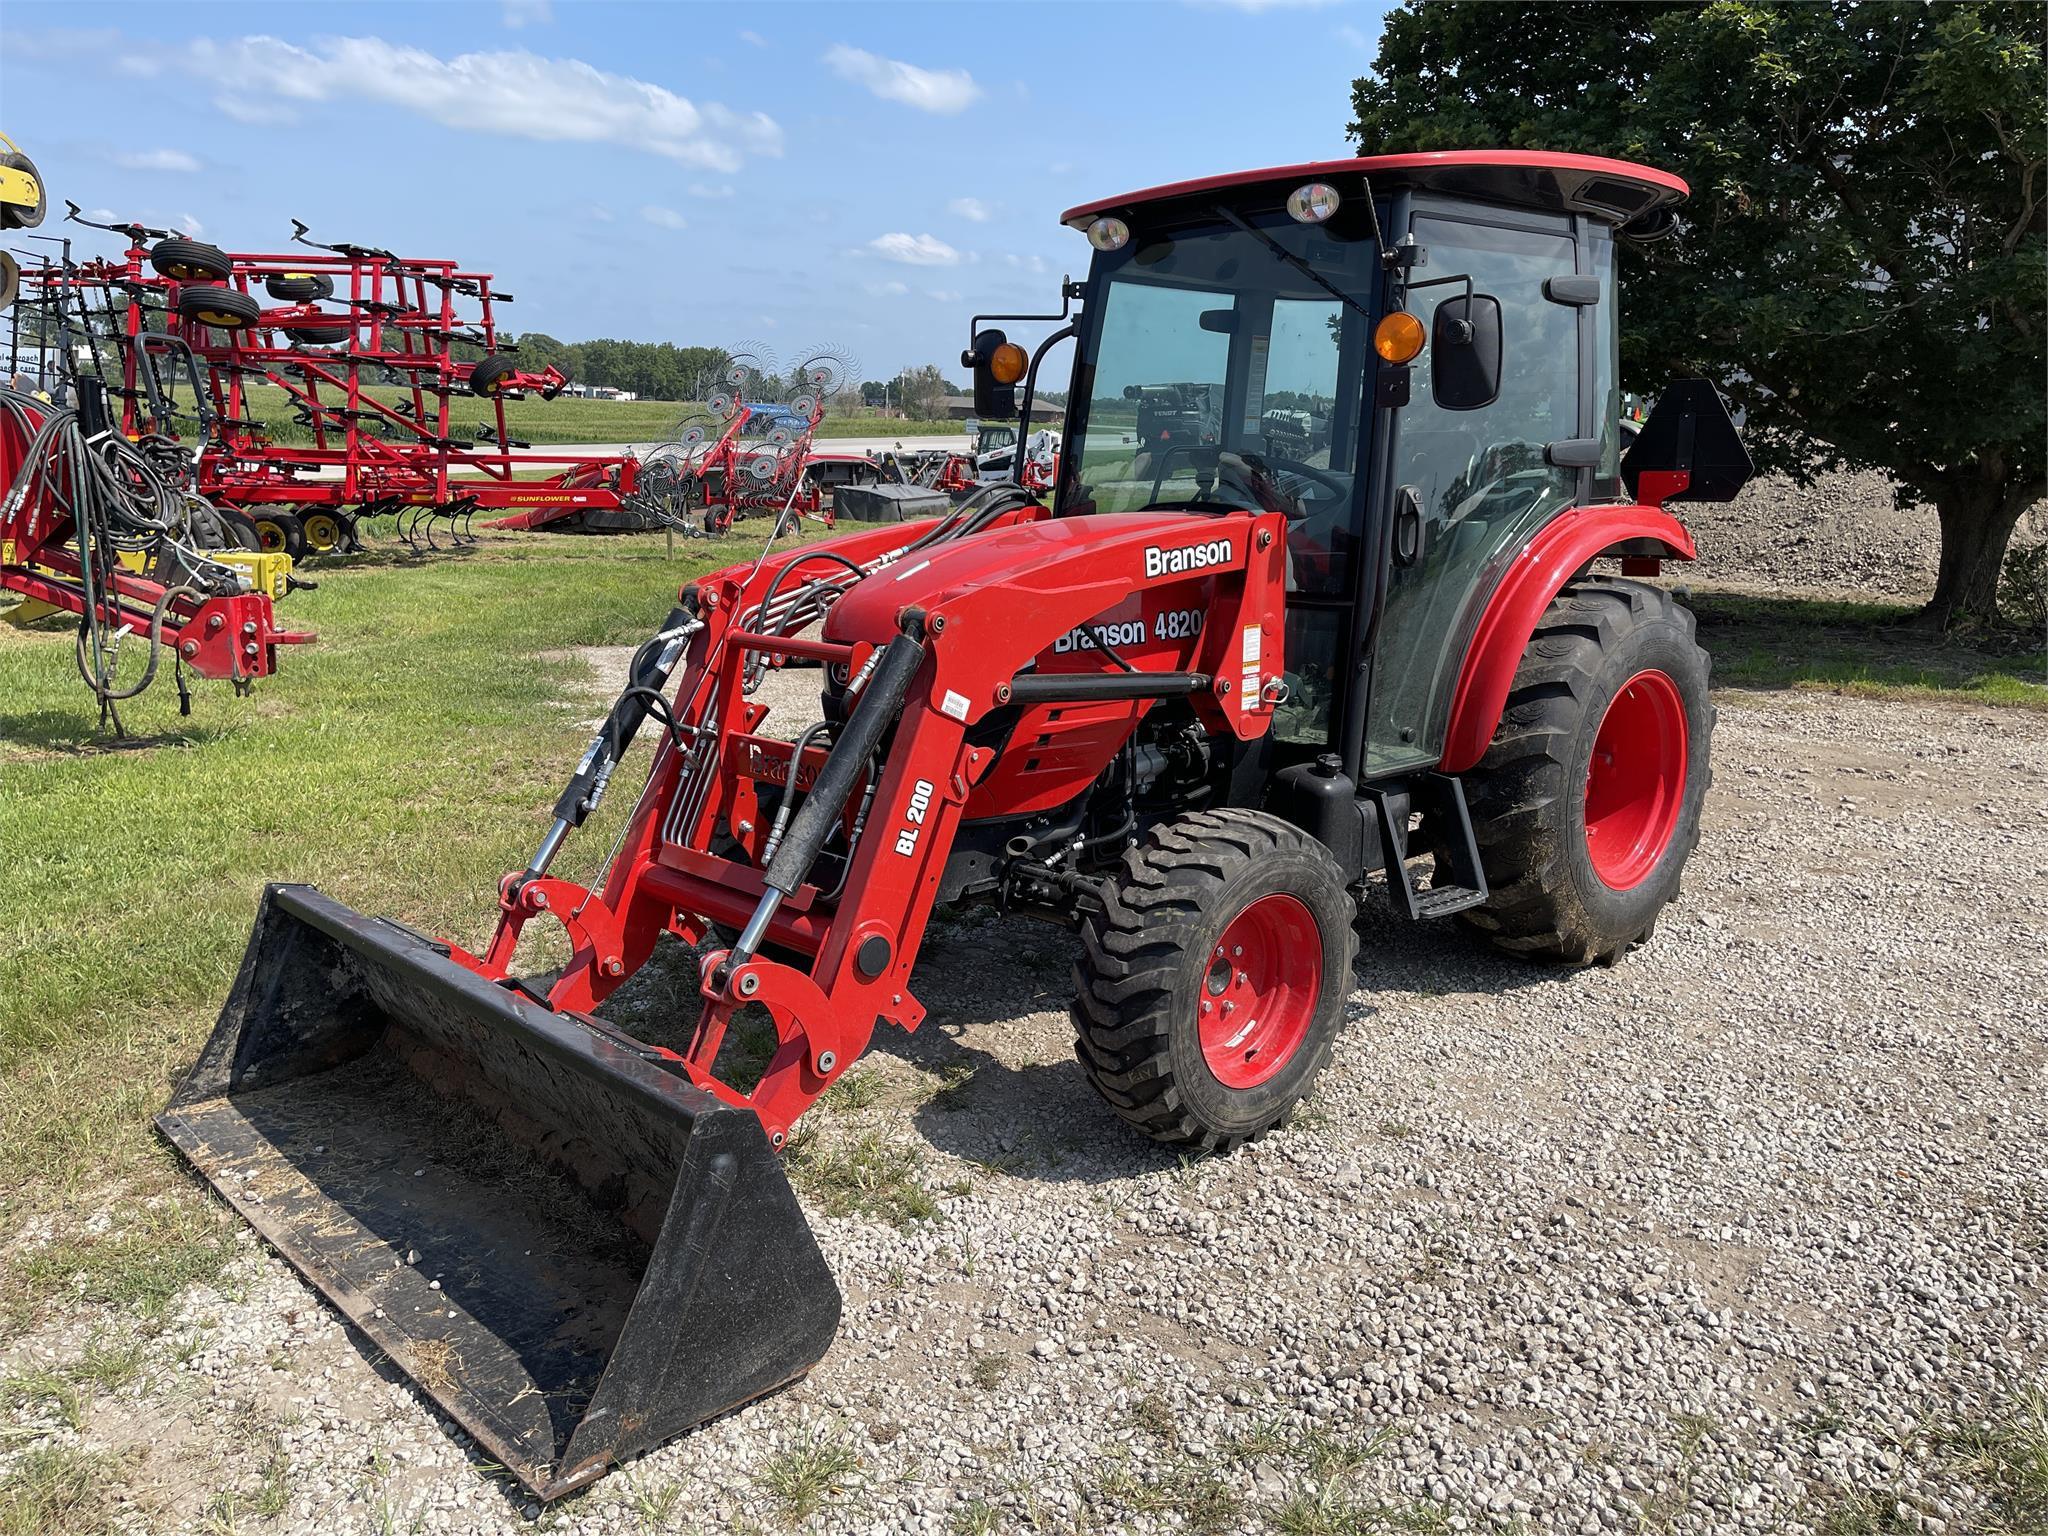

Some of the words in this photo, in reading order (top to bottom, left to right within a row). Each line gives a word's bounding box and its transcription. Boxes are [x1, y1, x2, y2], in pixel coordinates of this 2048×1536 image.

[1145, 540, 1231, 577] Branson
[1055, 621, 1145, 652] Branson
[1155, 610, 1207, 640] 4820
[749, 744, 824, 785] Branso
[905, 778, 935, 826] 200
[894, 828, 920, 858] BL
